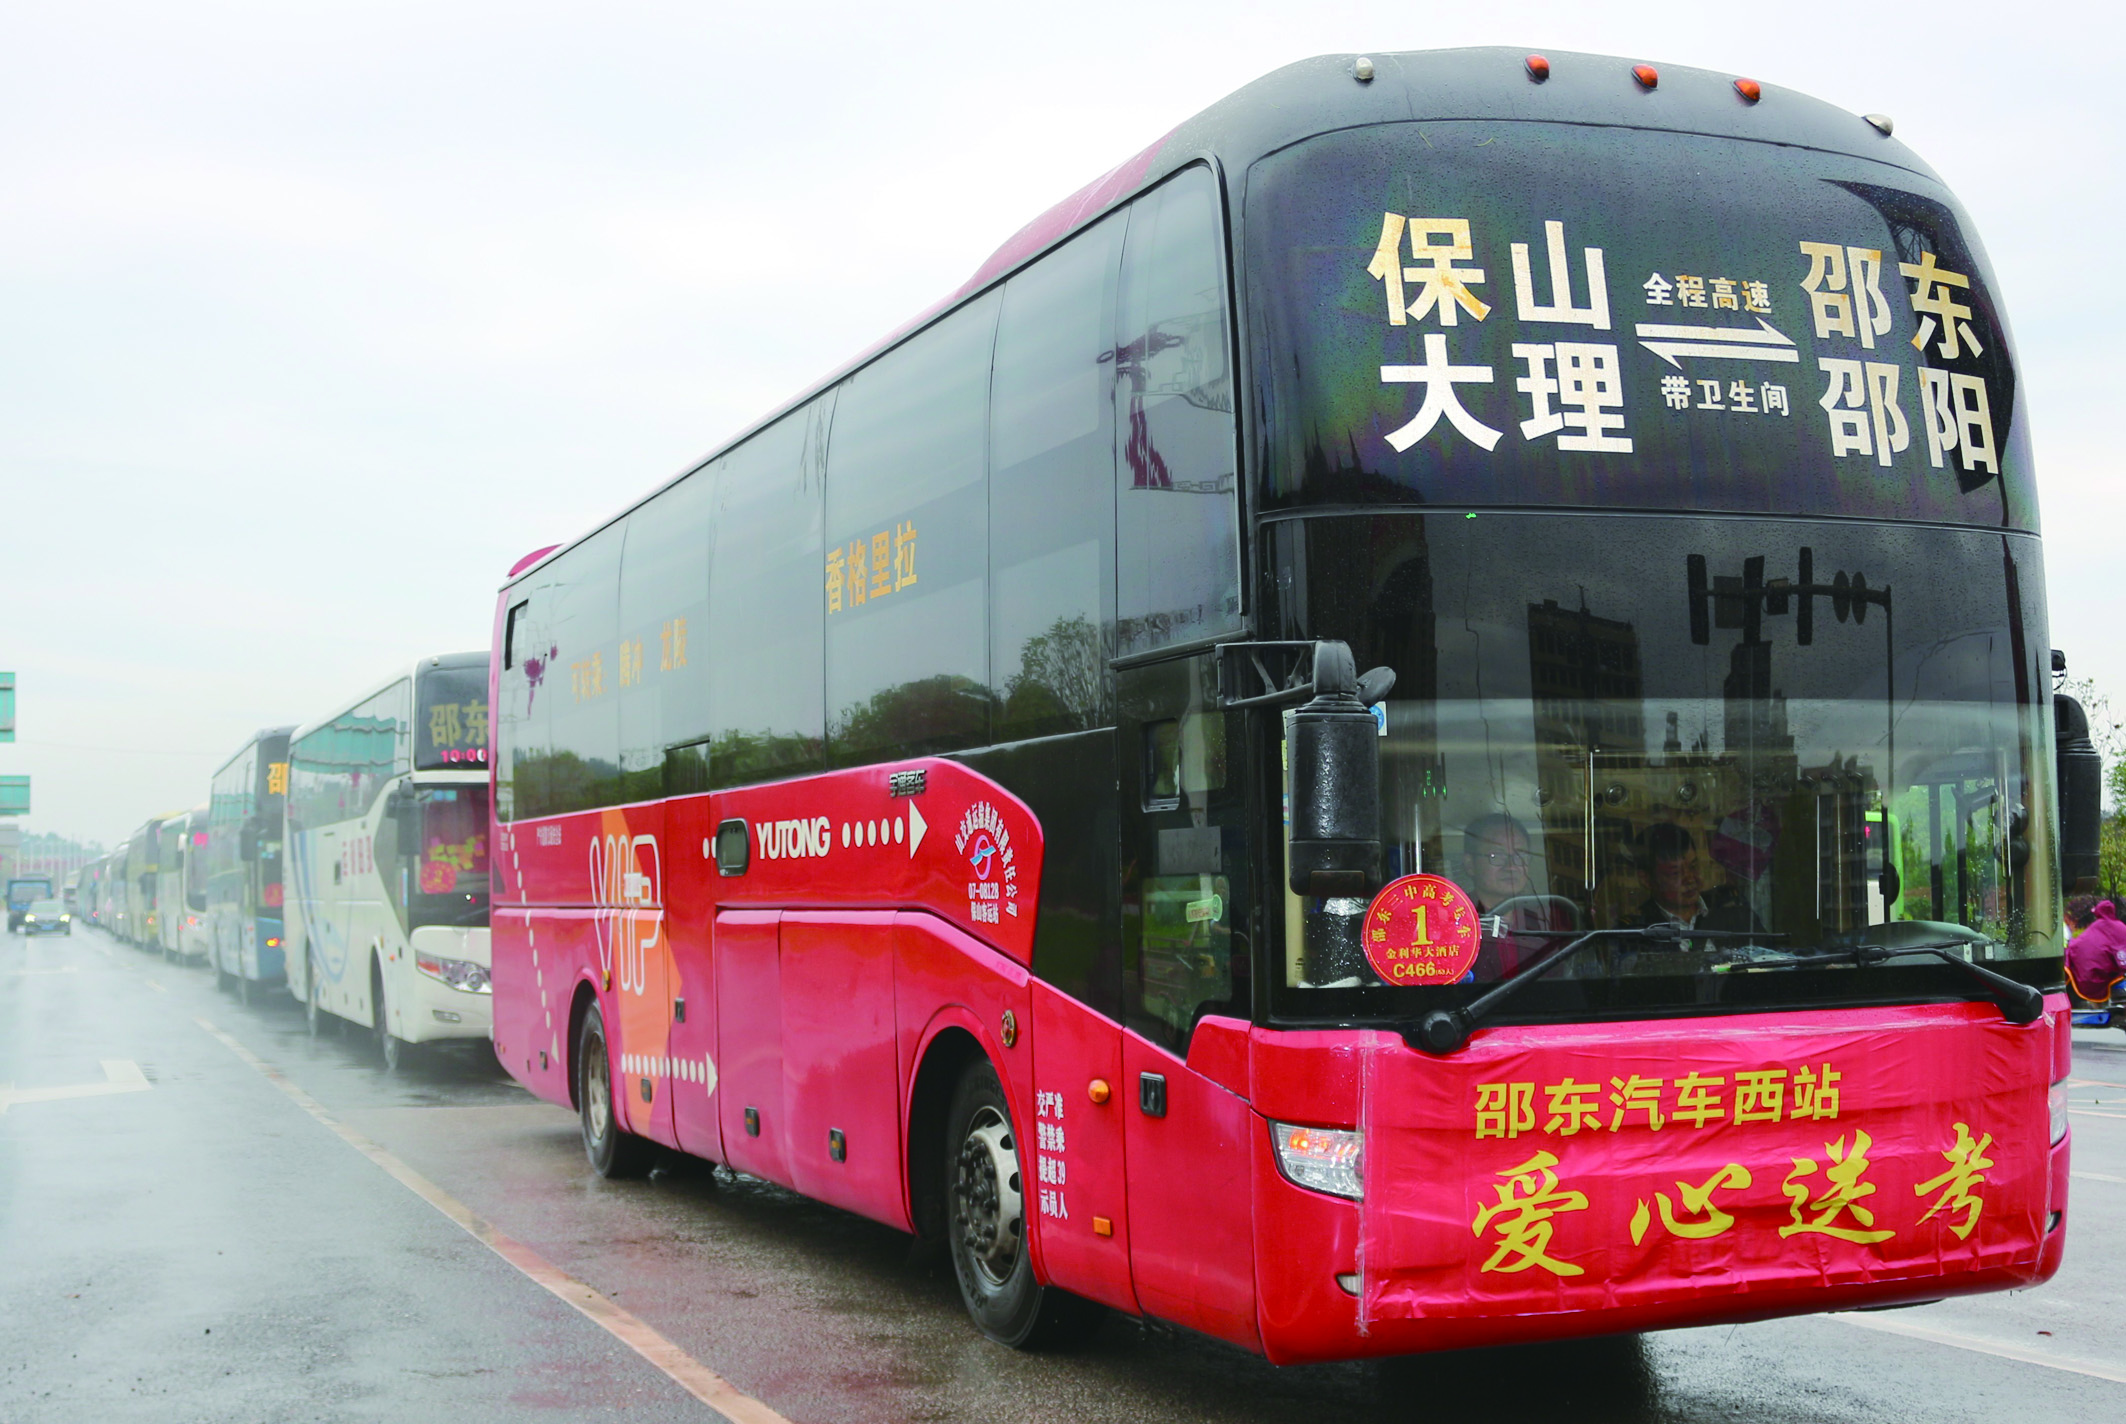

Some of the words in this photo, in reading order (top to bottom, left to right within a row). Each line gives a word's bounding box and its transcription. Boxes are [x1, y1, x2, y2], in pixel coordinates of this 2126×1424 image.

[1367, 211, 1611, 330] 保山
[1798, 240, 1984, 360] 邵东
[1641, 271, 1772, 314] 全程高速
[1380, 333, 1634, 454] 大理
[1818, 358, 1998, 475] 邵阳
[1660, 374, 1790, 418] 带卫生间
[825, 519, 918, 616] 香格里拉
[428, 698, 488, 748] 邵东
[440, 747, 488, 764] 10:00
[888, 769, 927, 798] 宇通客车
[755, 815, 832, 860] YUTONG
[968, 883, 999, 899] 07-08128
[971, 902, 999, 924] 保山客运站
[1372, 884, 1471, 942] 邵东三中高考专车
[1411, 905, 1433, 946] 1
[1386, 945, 1459, 959] 金利华大酒店
[1394, 962, 1435, 977] C466
[1473, 1062, 1842, 1140] 邵东汽车西站
[1471, 1122, 1995, 1278] 爱心送考
